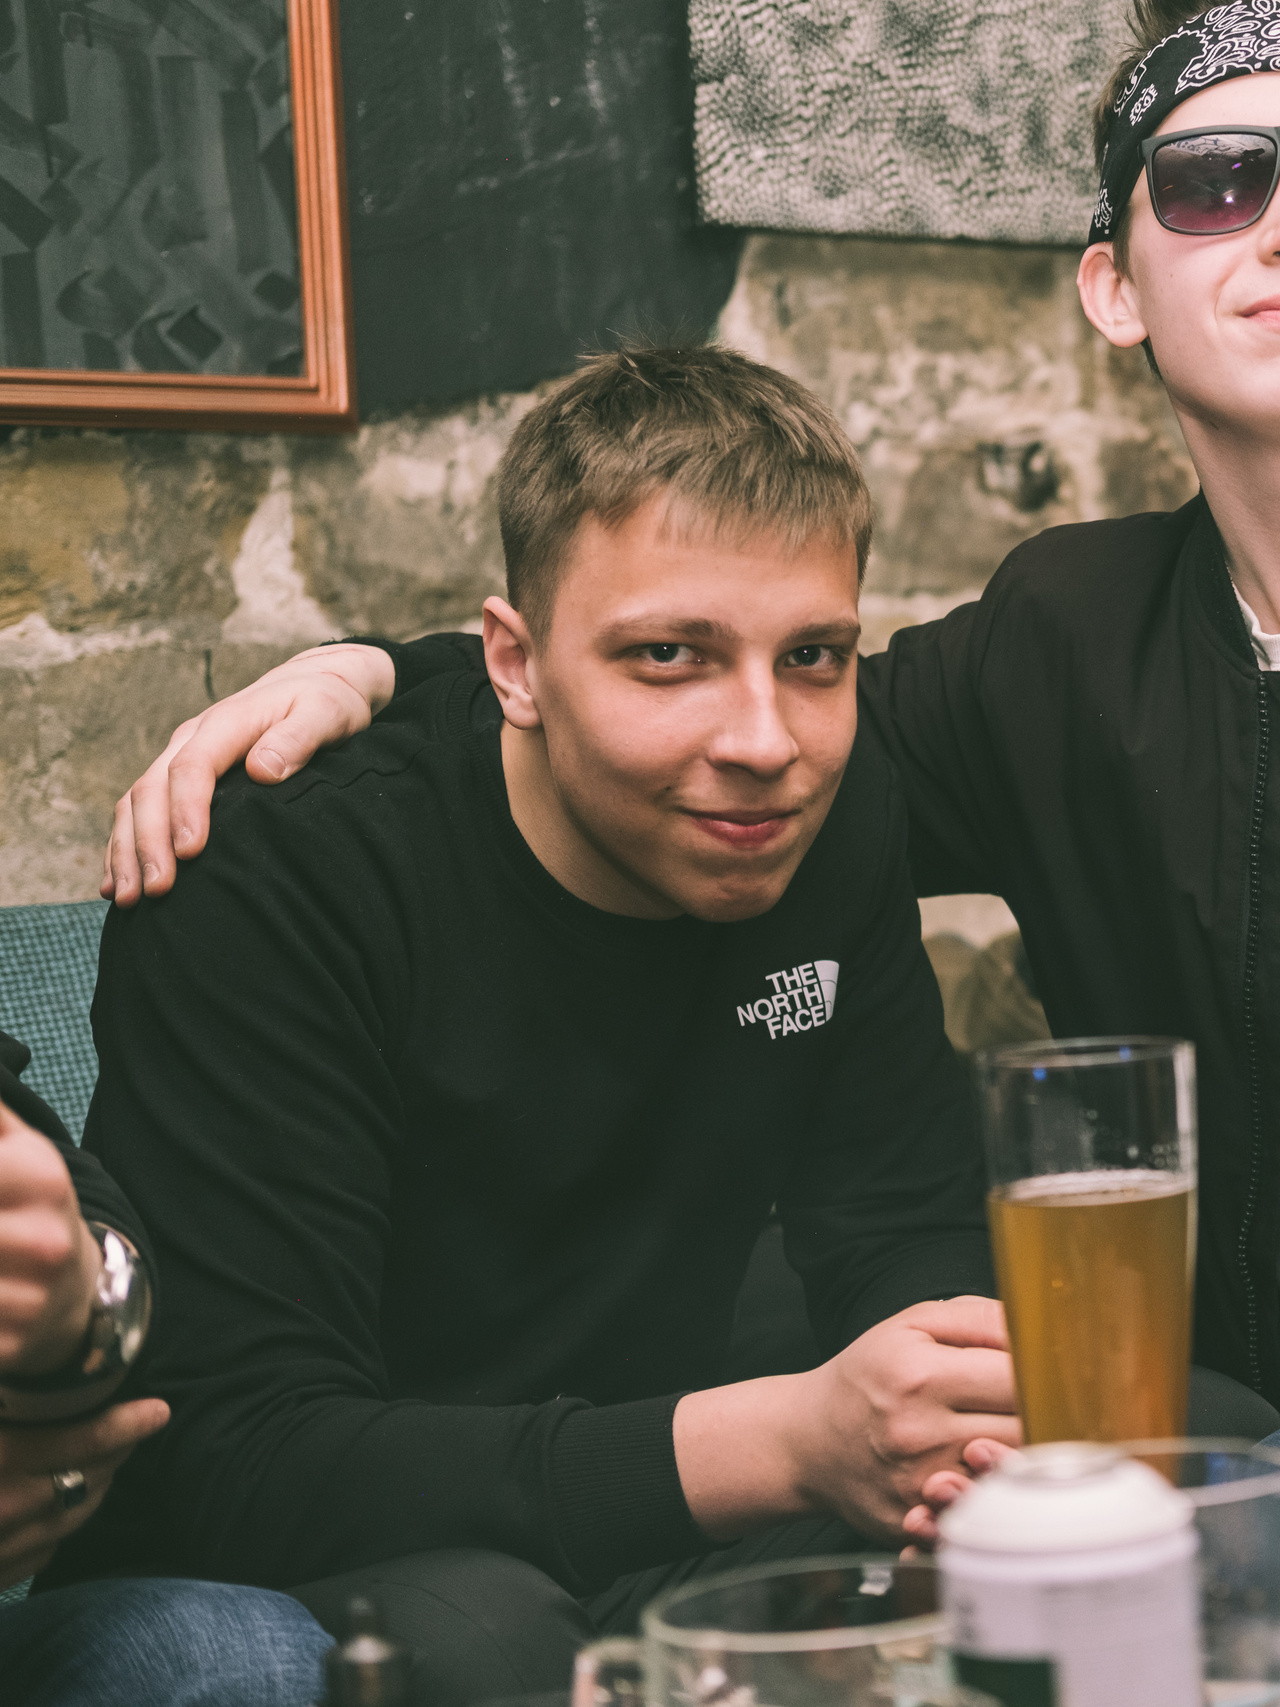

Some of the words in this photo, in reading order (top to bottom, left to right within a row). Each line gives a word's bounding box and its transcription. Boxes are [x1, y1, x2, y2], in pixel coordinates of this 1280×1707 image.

[765, 962, 817, 993] THE
[736, 983, 823, 1027] NORTH
[766, 1004, 826, 1040] FACE
